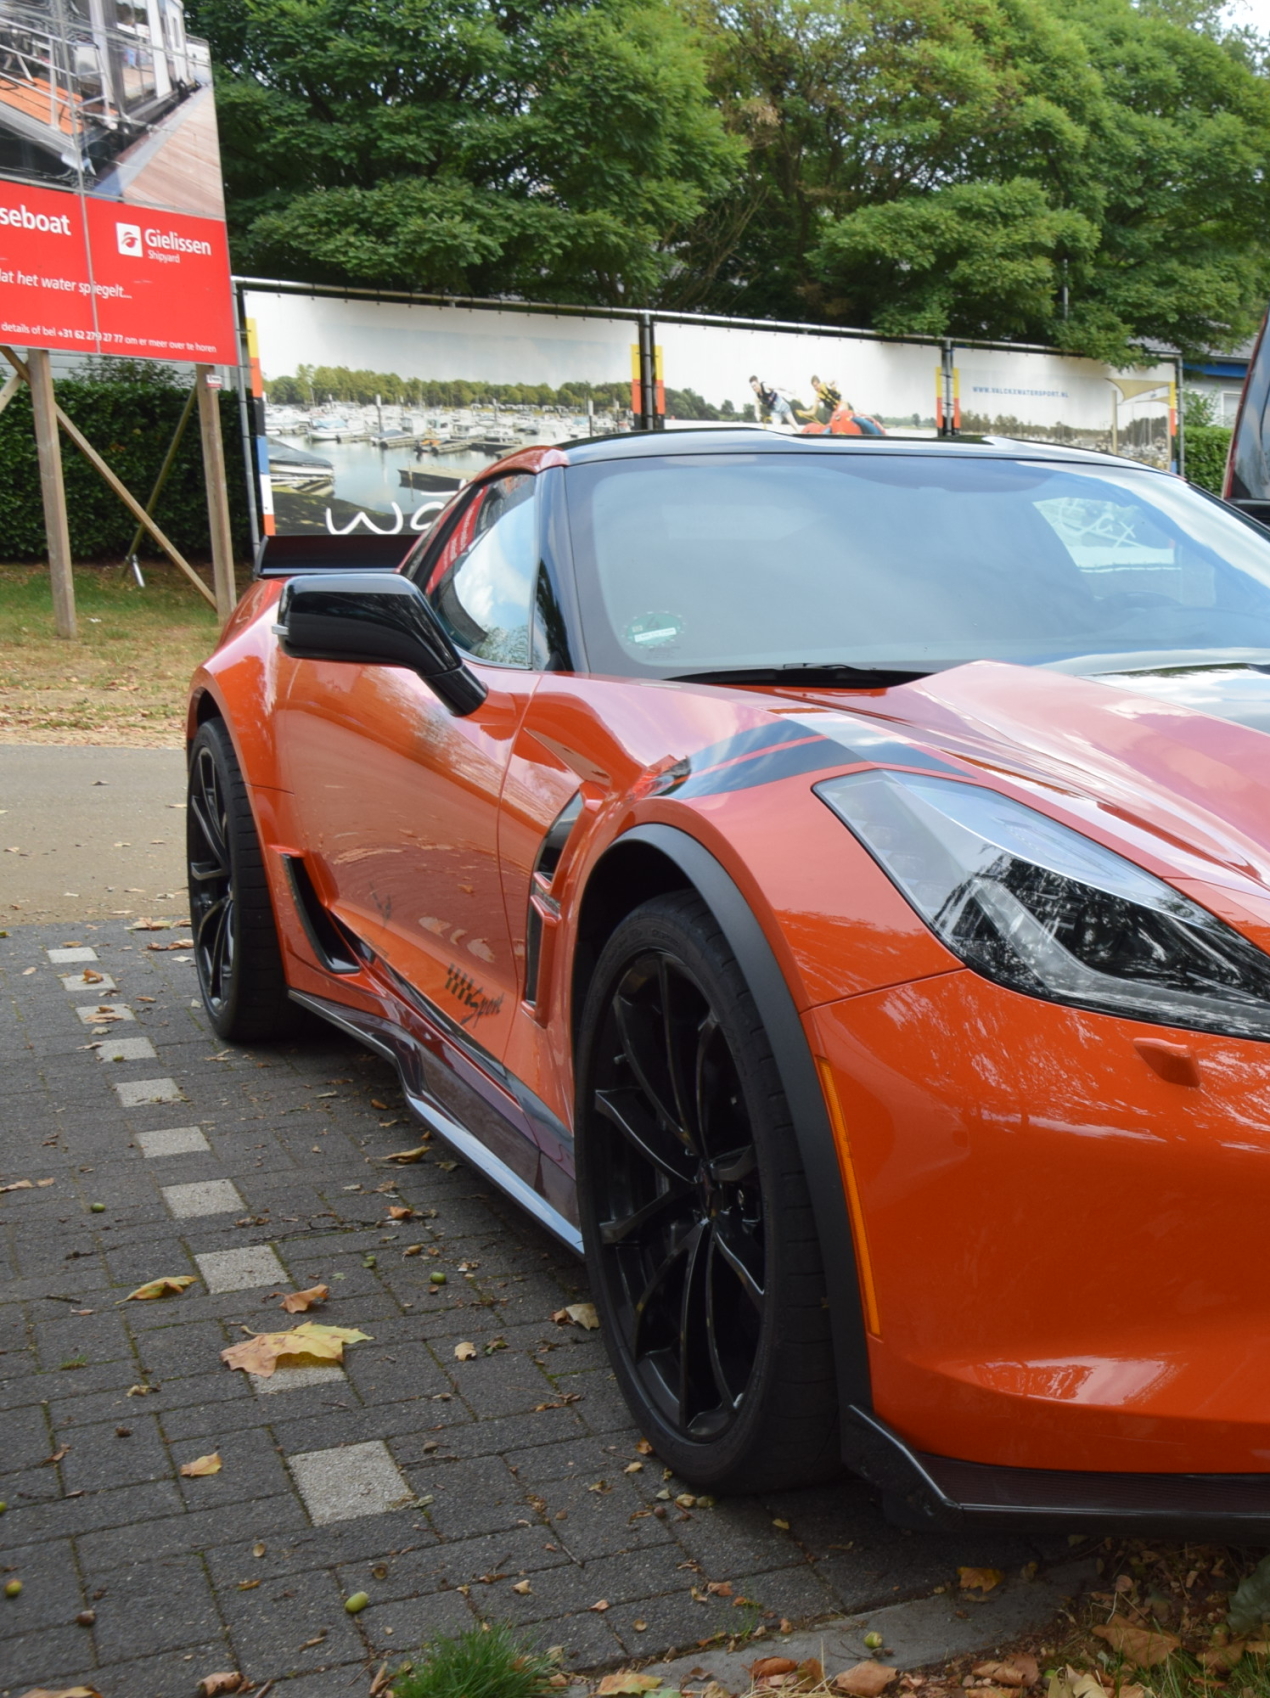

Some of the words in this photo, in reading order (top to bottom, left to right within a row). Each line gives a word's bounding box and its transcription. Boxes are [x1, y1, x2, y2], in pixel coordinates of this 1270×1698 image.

[0, 204, 71, 236] seboat
[144, 228, 212, 256] Gielissen
[147, 250, 181, 263] Shipyard
[17, 270, 39, 287] het
[41, 276, 76, 292] water
[1, 322, 30, 334] details
[31, 325, 41, 335] of
[43, 326, 56, 337] bel
[124, 337, 138, 345] om
[139, 338, 147, 346] er
[148, 339, 168, 348] meer
[169, 340, 185, 350] over
[186, 341, 195, 351] te
[195, 342, 217, 353] horen
